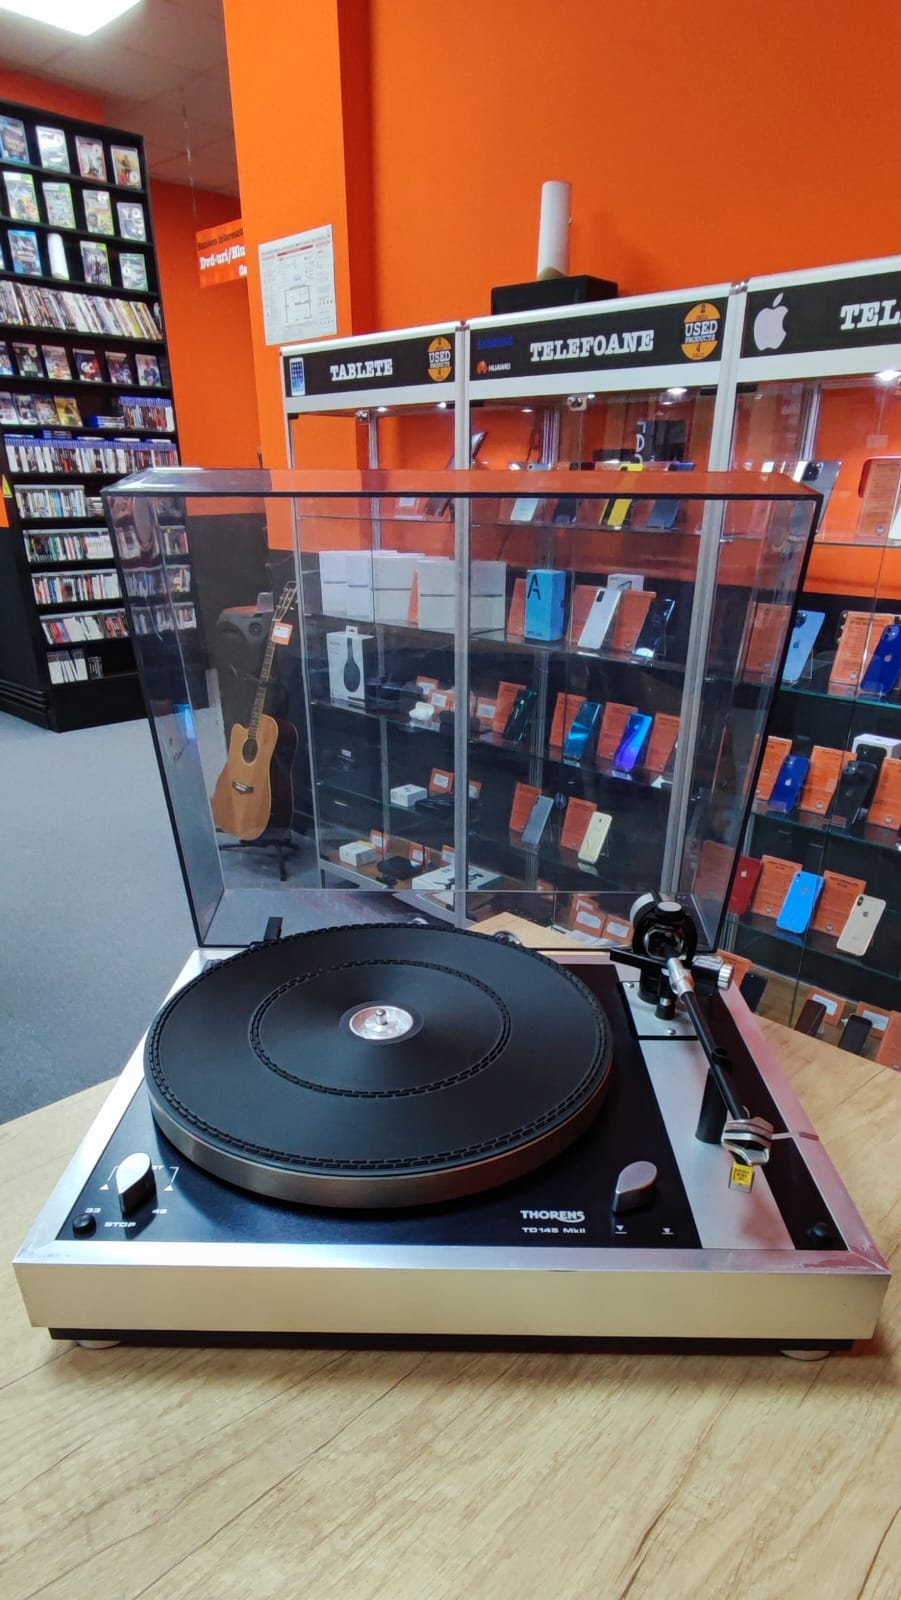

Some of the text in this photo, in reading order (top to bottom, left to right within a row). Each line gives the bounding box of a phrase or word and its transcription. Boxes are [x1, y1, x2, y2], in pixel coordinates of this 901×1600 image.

[840, 299, 901, 330] TEL
[685, 320, 718, 337] USED
[429, 351, 451, 363] USED
[529, 329, 655, 362] TELEFOANE
[329, 358, 393, 381] TABLETE
[527, 573, 541, 601] A
[520, 1210, 586, 1223] THORENS
